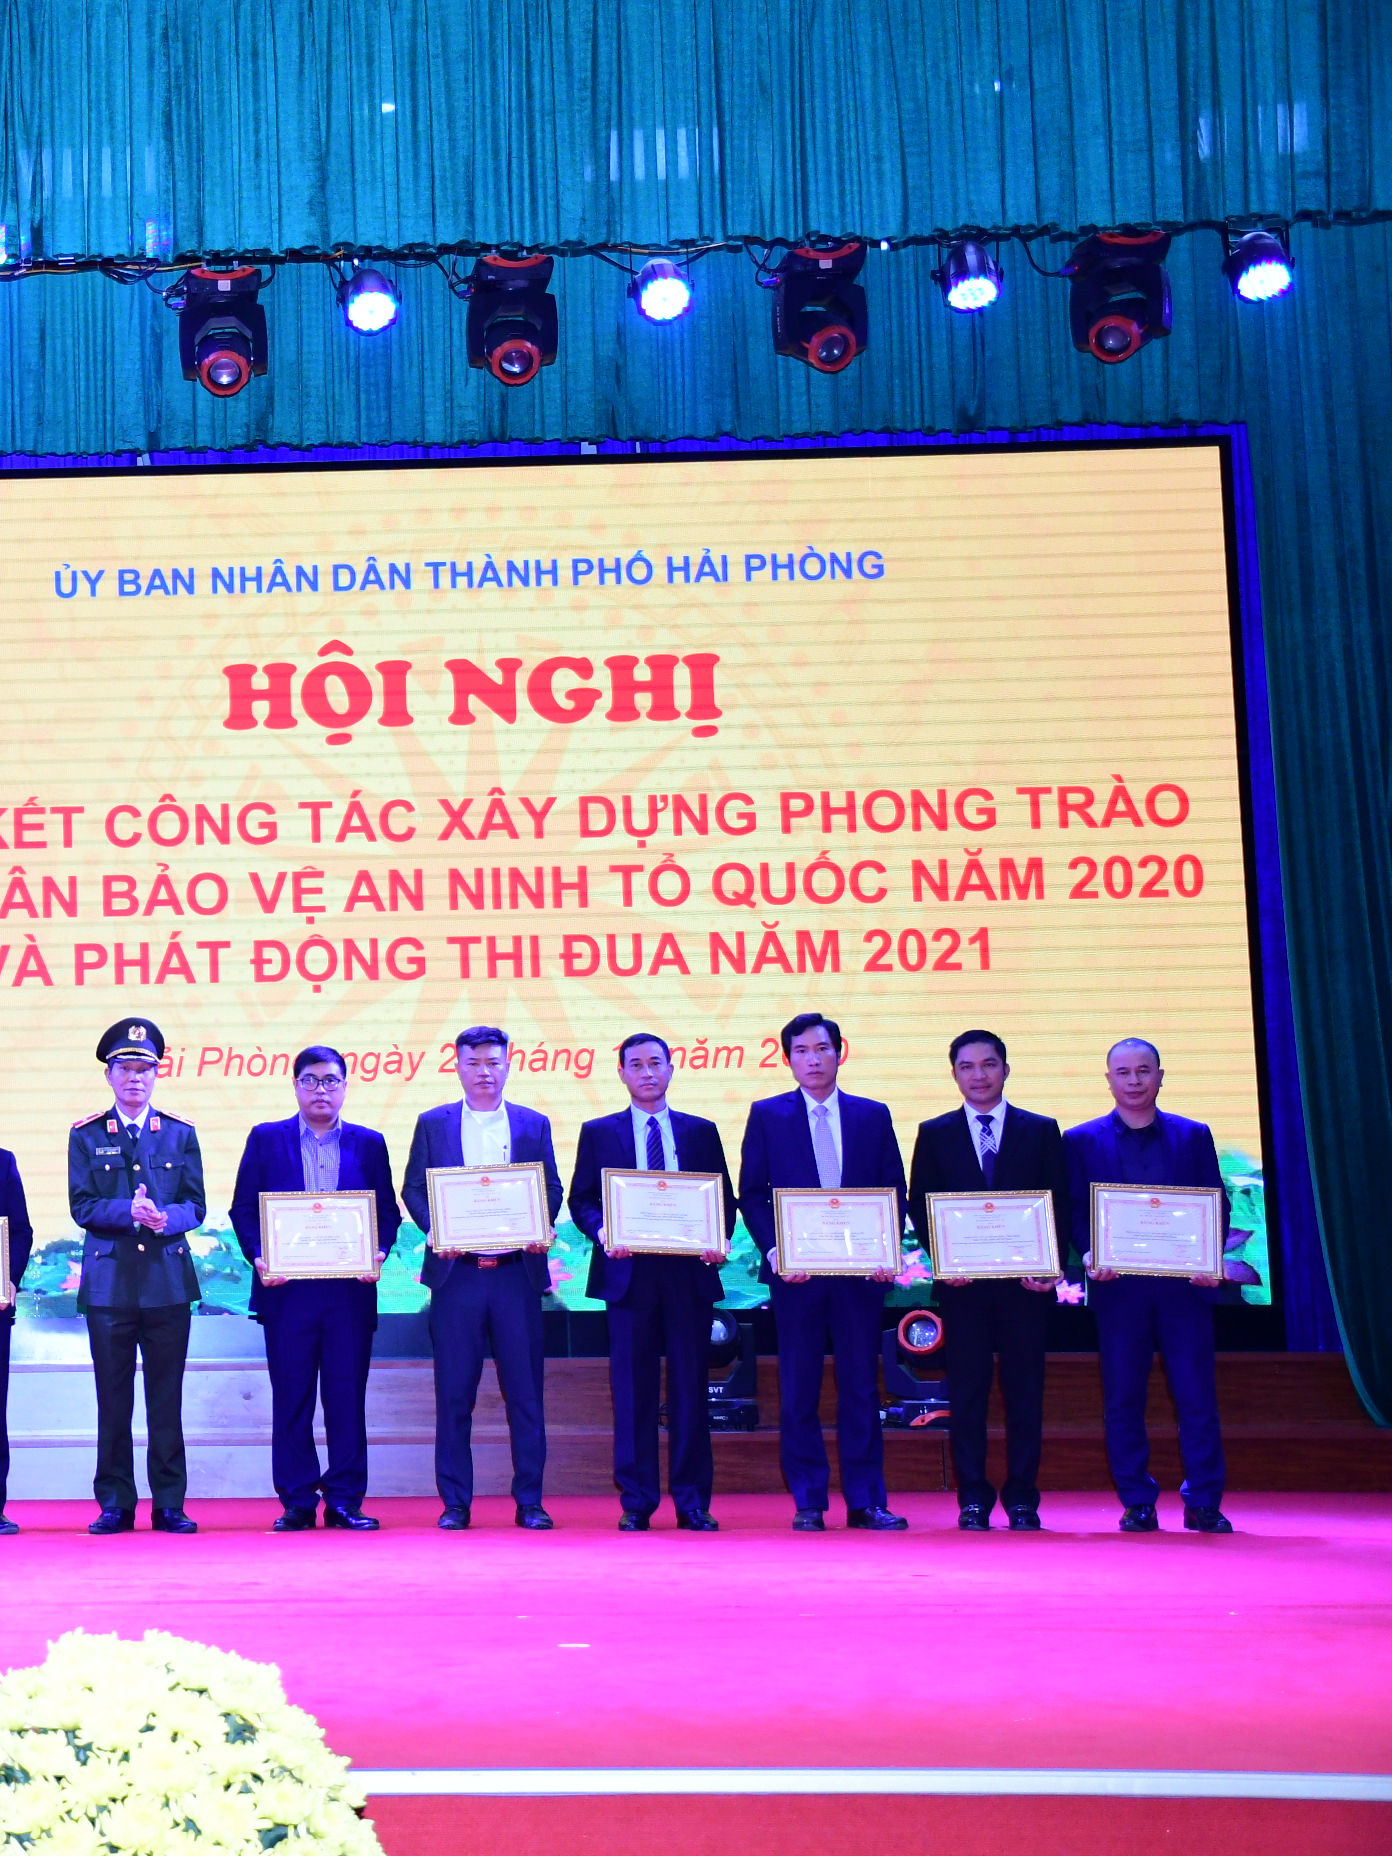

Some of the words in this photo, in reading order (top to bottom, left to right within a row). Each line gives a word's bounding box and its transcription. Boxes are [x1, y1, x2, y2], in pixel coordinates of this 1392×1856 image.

[54, 561, 106, 599] ỦY
[118, 567, 196, 597] BAN
[211, 558, 320, 595] NHÂN
[332, 555, 413, 592] DÂN
[423, 552, 559, 590] THÀNH
[571, 549, 655, 586] PHỐ
[666, 547, 729, 584] HẢI
[744, 545, 886, 582] PHÒNG
[222, 639, 414, 746] HỘI
[444, 652, 723, 739] NGHỊ
[104, 793, 278, 849] CÔNG
[298, 789, 417, 844] TÁC
[437, 786, 558, 841] XÂY
[578, 792, 757, 849] DỰNG
[780, 787, 997, 835] PHONG
[1016, 773, 1190, 830] TRÀO
[102, 862, 229, 917] BẢO
[249, 865, 327, 925] VỆ
[343, 868, 424, 913] AN
[448, 865, 589, 911] NINH
[608, 853, 691, 908] TỔ
[711, 849, 889, 909] QUỐC
[912, 847, 1045, 903] NĂM
[1068, 853, 1205, 900] 2020
[74, 930, 231, 986] PHÁT
[250, 933, 427, 994] ĐỘNG
[446, 934, 541, 980] THI
[558, 932, 691, 978] ĐUA
[709, 920, 841, 975] NĂM
[864, 926, 991, 973] 2021
[156, 1045, 186, 1079] ải
[196, 1045, 298, 1078] Phòn
[341, 1043, 426, 1083] ngày
[506, 1041, 595, 1079] háng
[669, 1037, 744, 1070] năm
[708, 1386, 724, 1394] SVT
